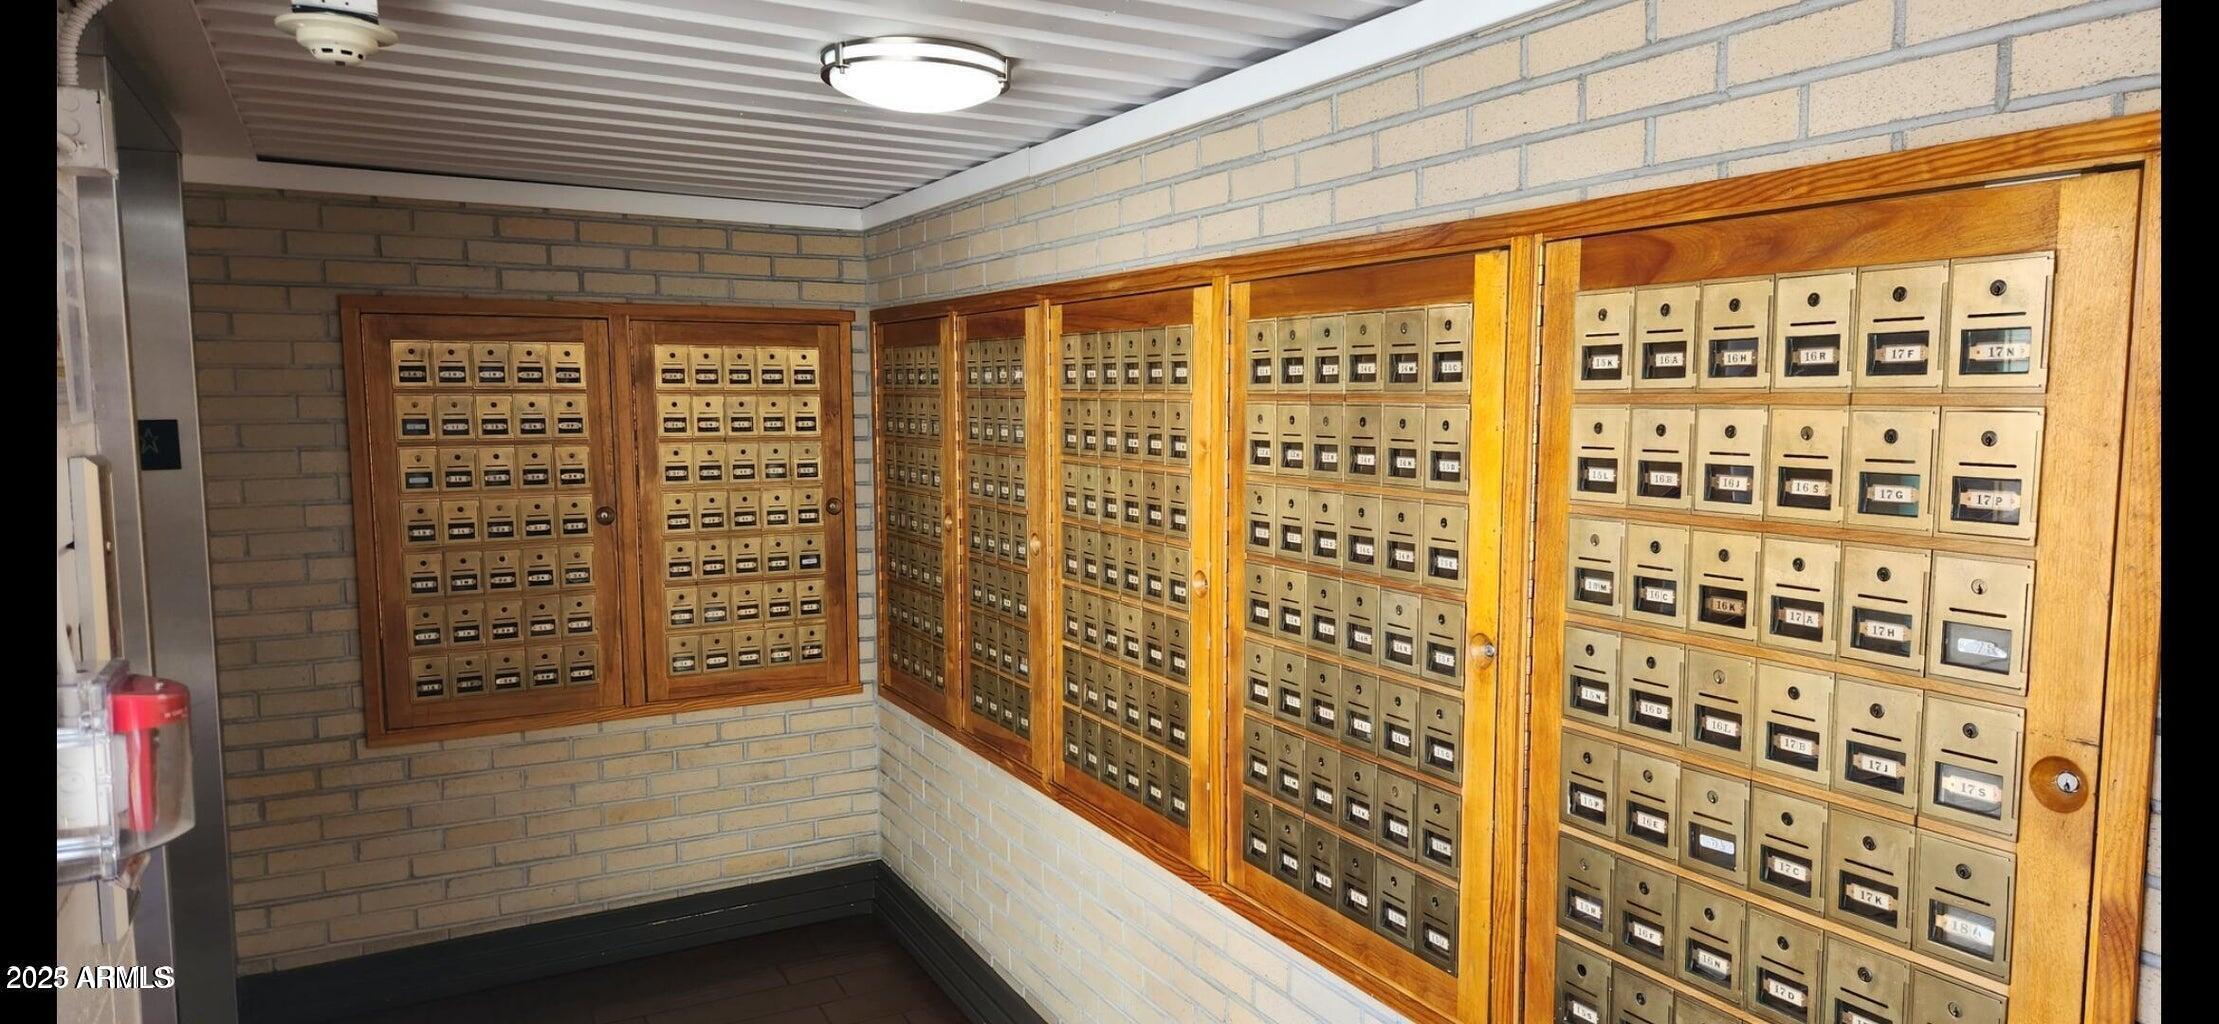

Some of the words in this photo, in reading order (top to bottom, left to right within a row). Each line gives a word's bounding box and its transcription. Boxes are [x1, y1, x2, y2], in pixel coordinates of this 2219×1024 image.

[1805, 351, 1826, 361] 16R
[1892, 349, 1914, 359] 17F
[1989, 347, 2014, 357] 17N
[1596, 358, 1612, 367] 15K
[1660, 356, 1678, 365] 16A
[1728, 354, 1747, 362] 16H
[1724, 479, 1740, 488] 16J
[1797, 482, 1819, 494] 16S
[1881, 490, 1903, 499] 17G
[1978, 495, 2002, 506] 17P
[1650, 590, 1667, 600] 16C
[1717, 601, 1736, 611] 16K
[1790, 612, 1813, 624] 17A
[1873, 626, 1895, 637] 17H
[1645, 704, 1662, 715] 16D
[1712, 721, 1731, 733] 16L
[1785, 738, 1805, 751] 17B
[1961, 783, 1986, 798] 17S
[1780, 862, 1799, 875] 17C
[1861, 890, 1882, 905] 17K
[1774, 985, 1794, 1000] 17D
